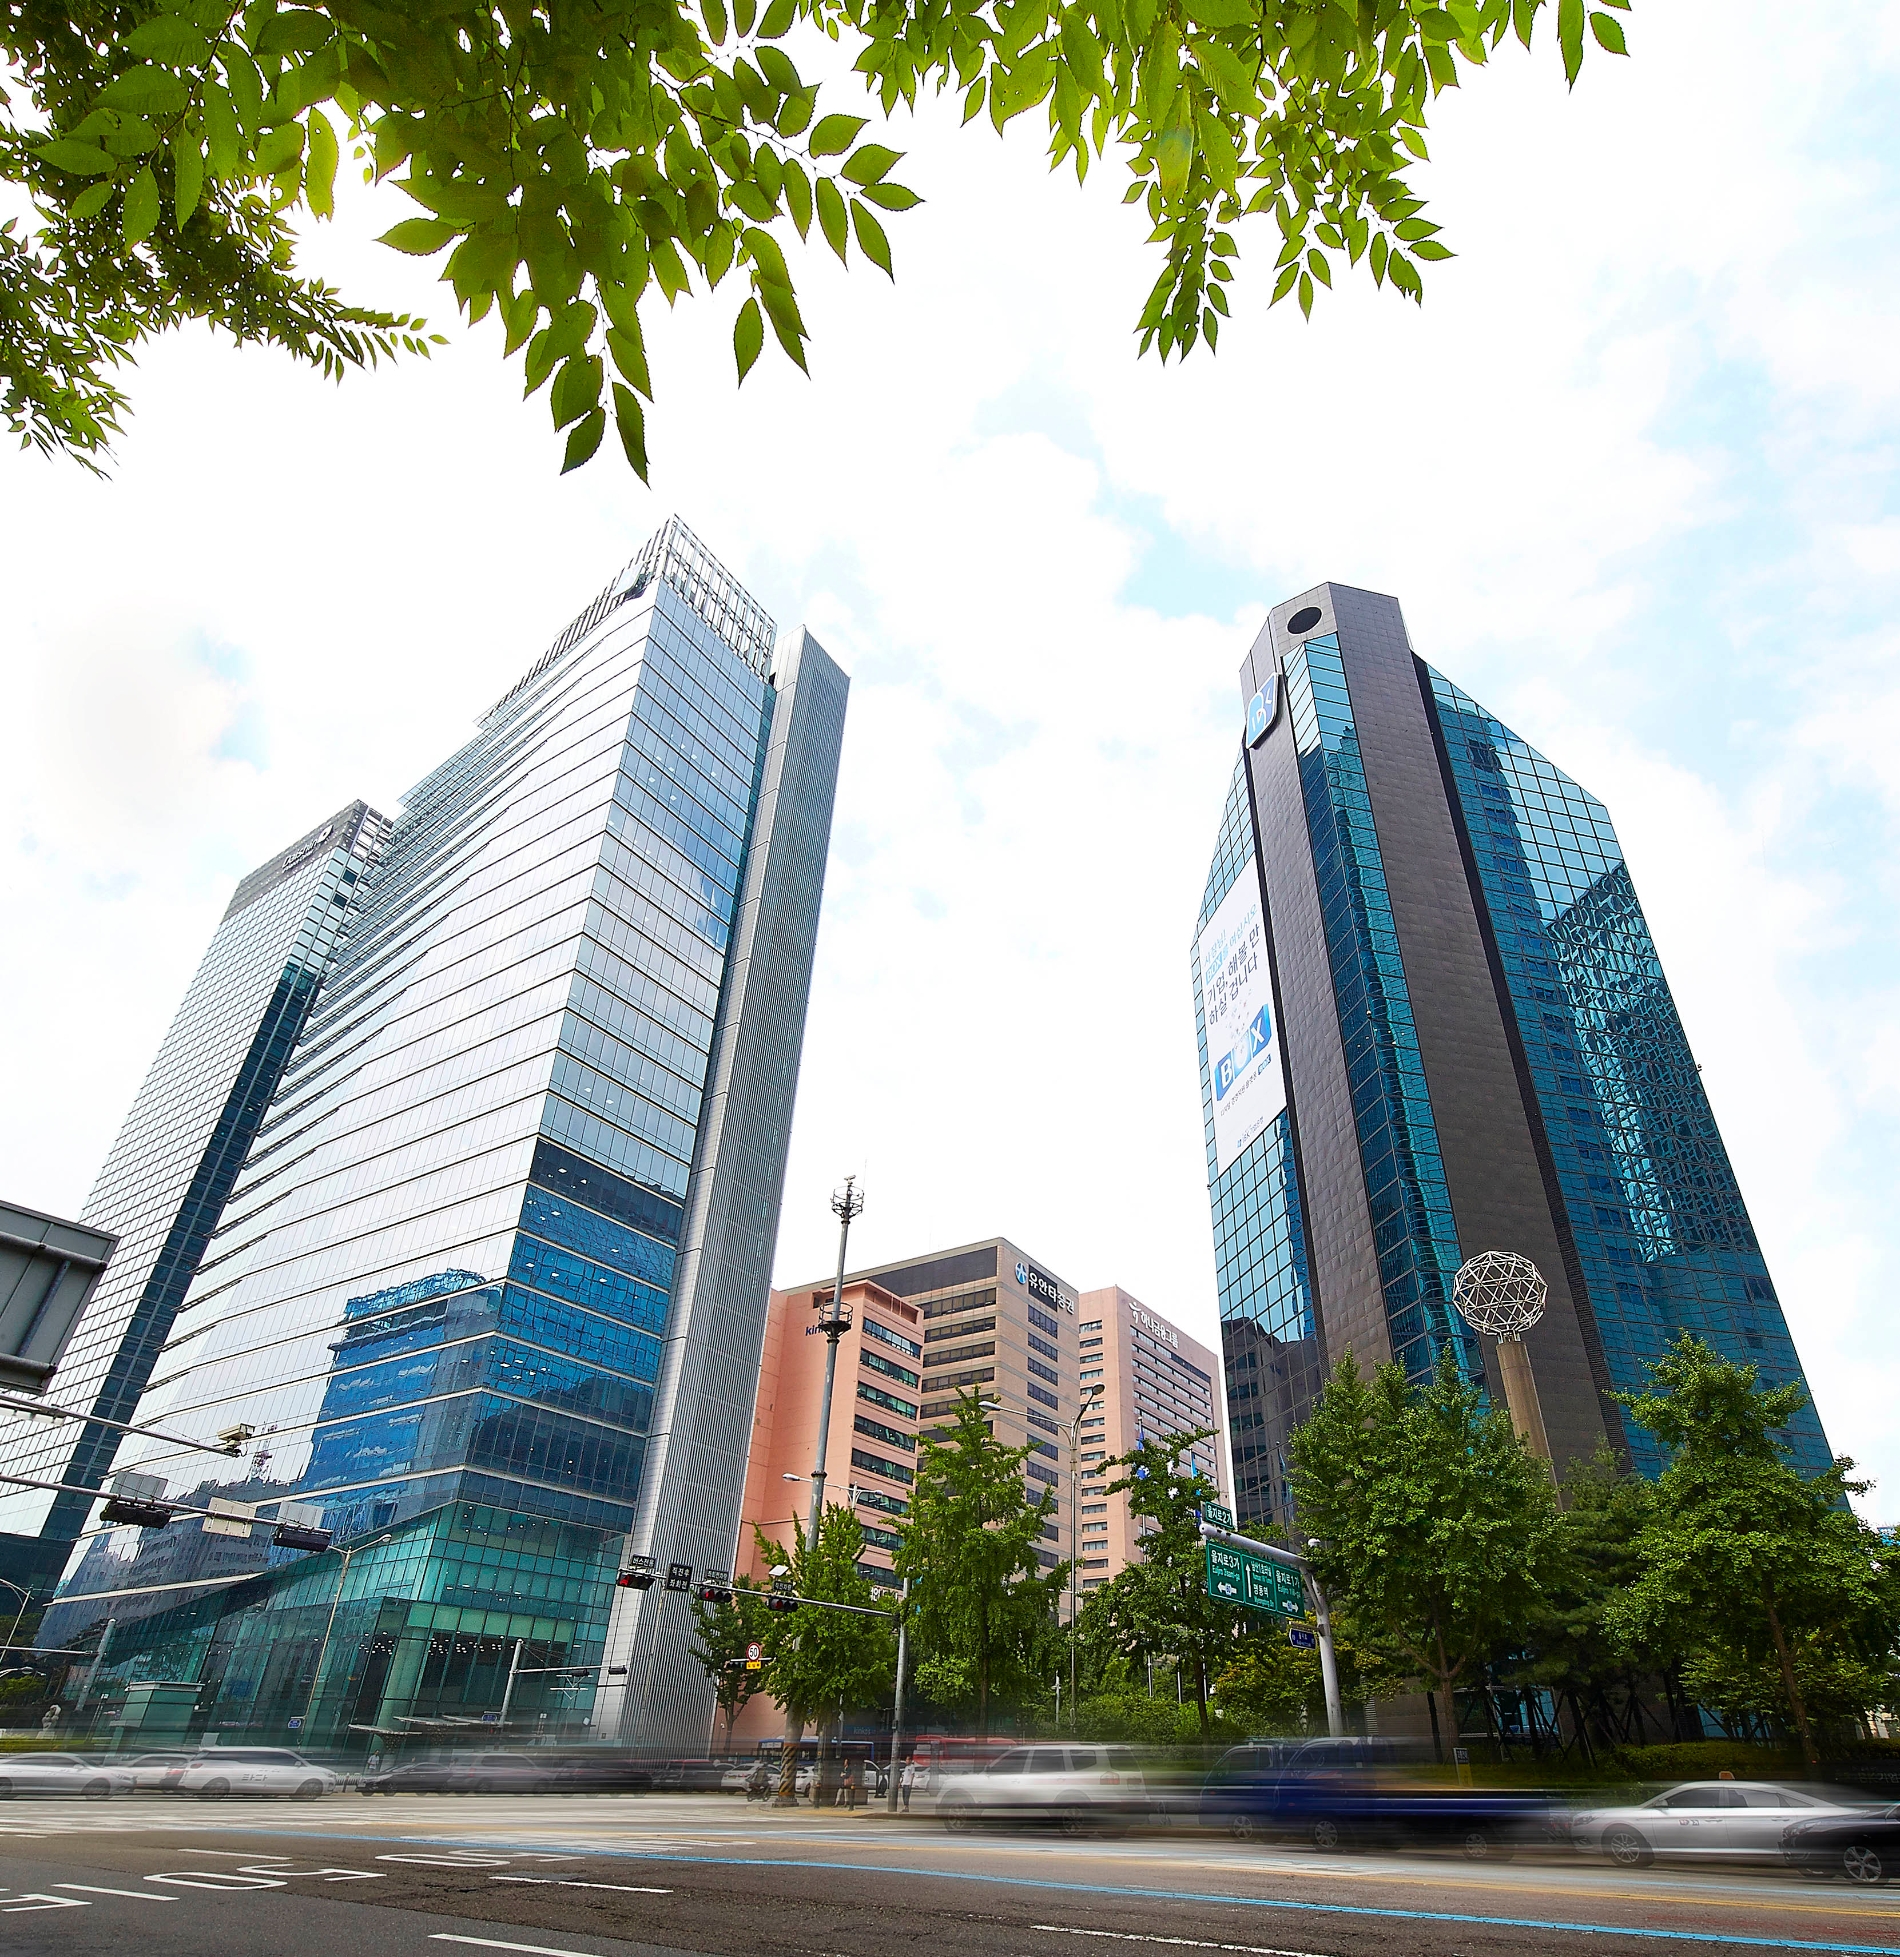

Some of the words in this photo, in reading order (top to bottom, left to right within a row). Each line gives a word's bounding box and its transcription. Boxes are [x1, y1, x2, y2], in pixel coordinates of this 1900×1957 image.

[1227, 940, 1248, 976] 해볼
[1249, 923, 1260, 949] 만
[1208, 993, 1228, 1025] 하실
[1229, 952, 1258, 1001] 겁니다
[1029, 1272, 1075, 1315] 유안타증권
[1140, 1311, 1179, 1350] 하나금융그룹
[1207, 1504, 1232, 1525] 을지로2가
[1211, 1549, 1240, 1571] 을지로3가
[1276, 1569, 1300, 1589] 을지로1가
[749, 1647, 758, 1658] 50
